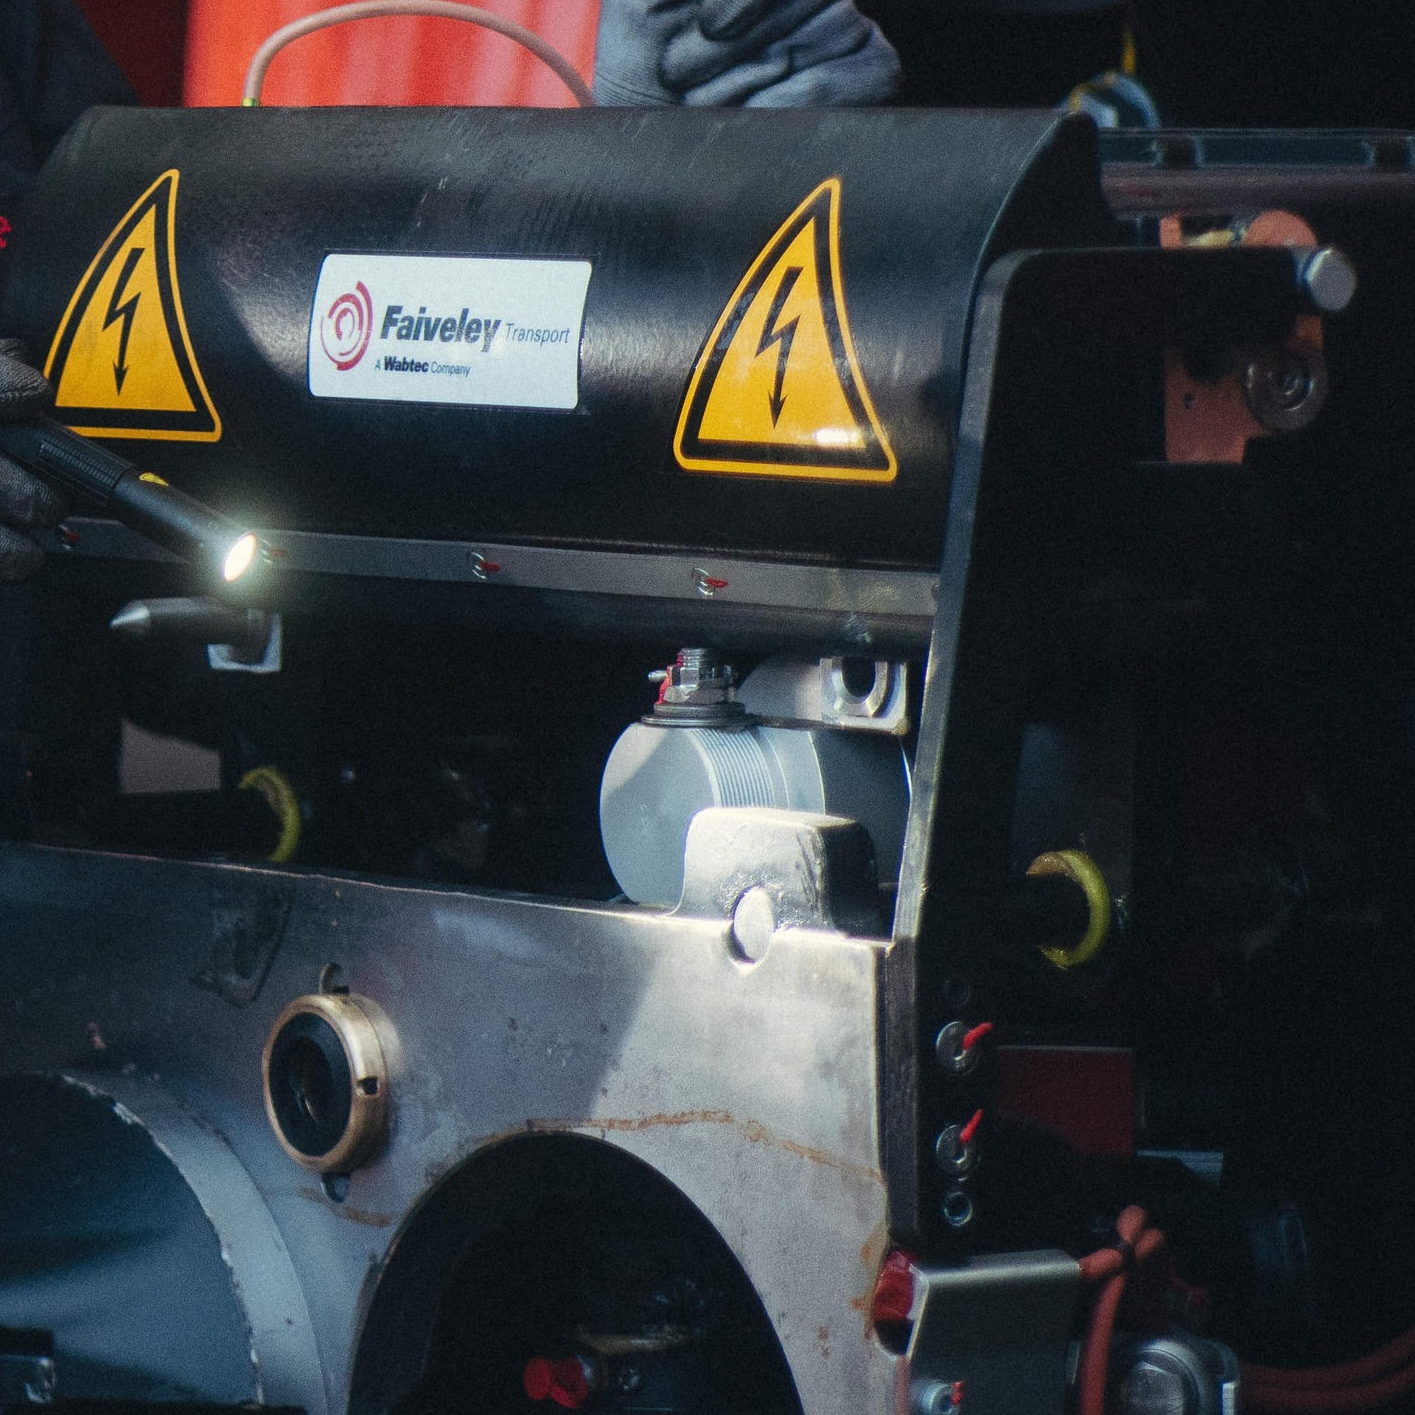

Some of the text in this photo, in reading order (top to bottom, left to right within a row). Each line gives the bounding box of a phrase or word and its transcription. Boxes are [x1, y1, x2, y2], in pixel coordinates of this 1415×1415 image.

[379, 305, 571, 353] Faiveley Transport
[374, 355, 471, 377] A Wabtec Company
